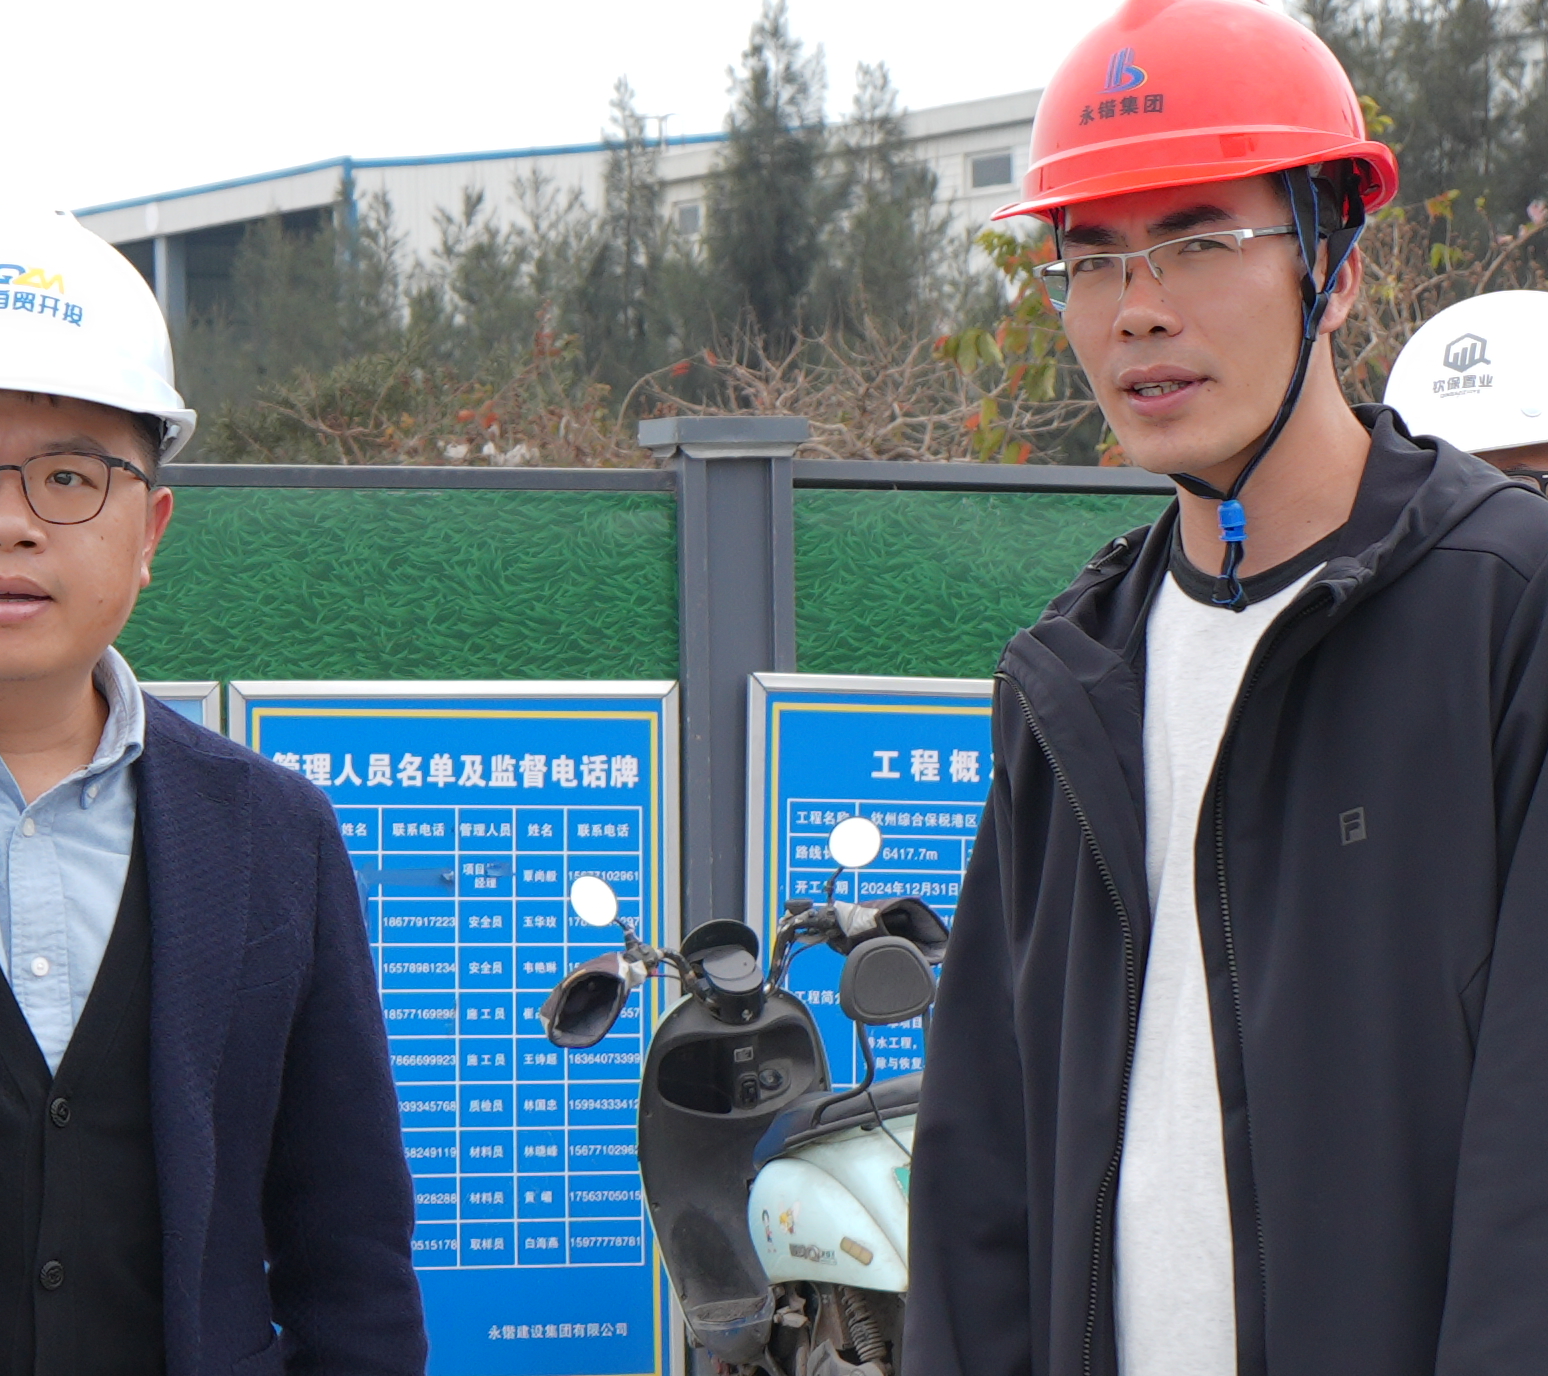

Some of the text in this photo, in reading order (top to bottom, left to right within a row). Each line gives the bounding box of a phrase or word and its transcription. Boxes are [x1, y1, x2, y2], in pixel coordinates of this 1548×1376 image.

[1078, 94, 1165, 125] 永锴集团
[870, 748, 994, 784] 工程概
[340, 822, 368, 837] 姓名
[392, 822, 445, 837] 联系电话
[459, 822, 512, 838] 管理人员
[527, 823, 553, 837] 姓名
[577, 823, 630, 838] 联系电话
[882, 847, 939, 861] 6417.7m
[795, 880, 849, 895] 开工期
[468, 915, 503, 929] 安全员
[469, 961, 503, 975] 安全员
[466, 1007, 505, 1021] 施工员
[466, 1053, 506, 1067] 施工员
[469, 1145, 504, 1158] 材料员
[469, 1191, 504, 1204] 材料员
